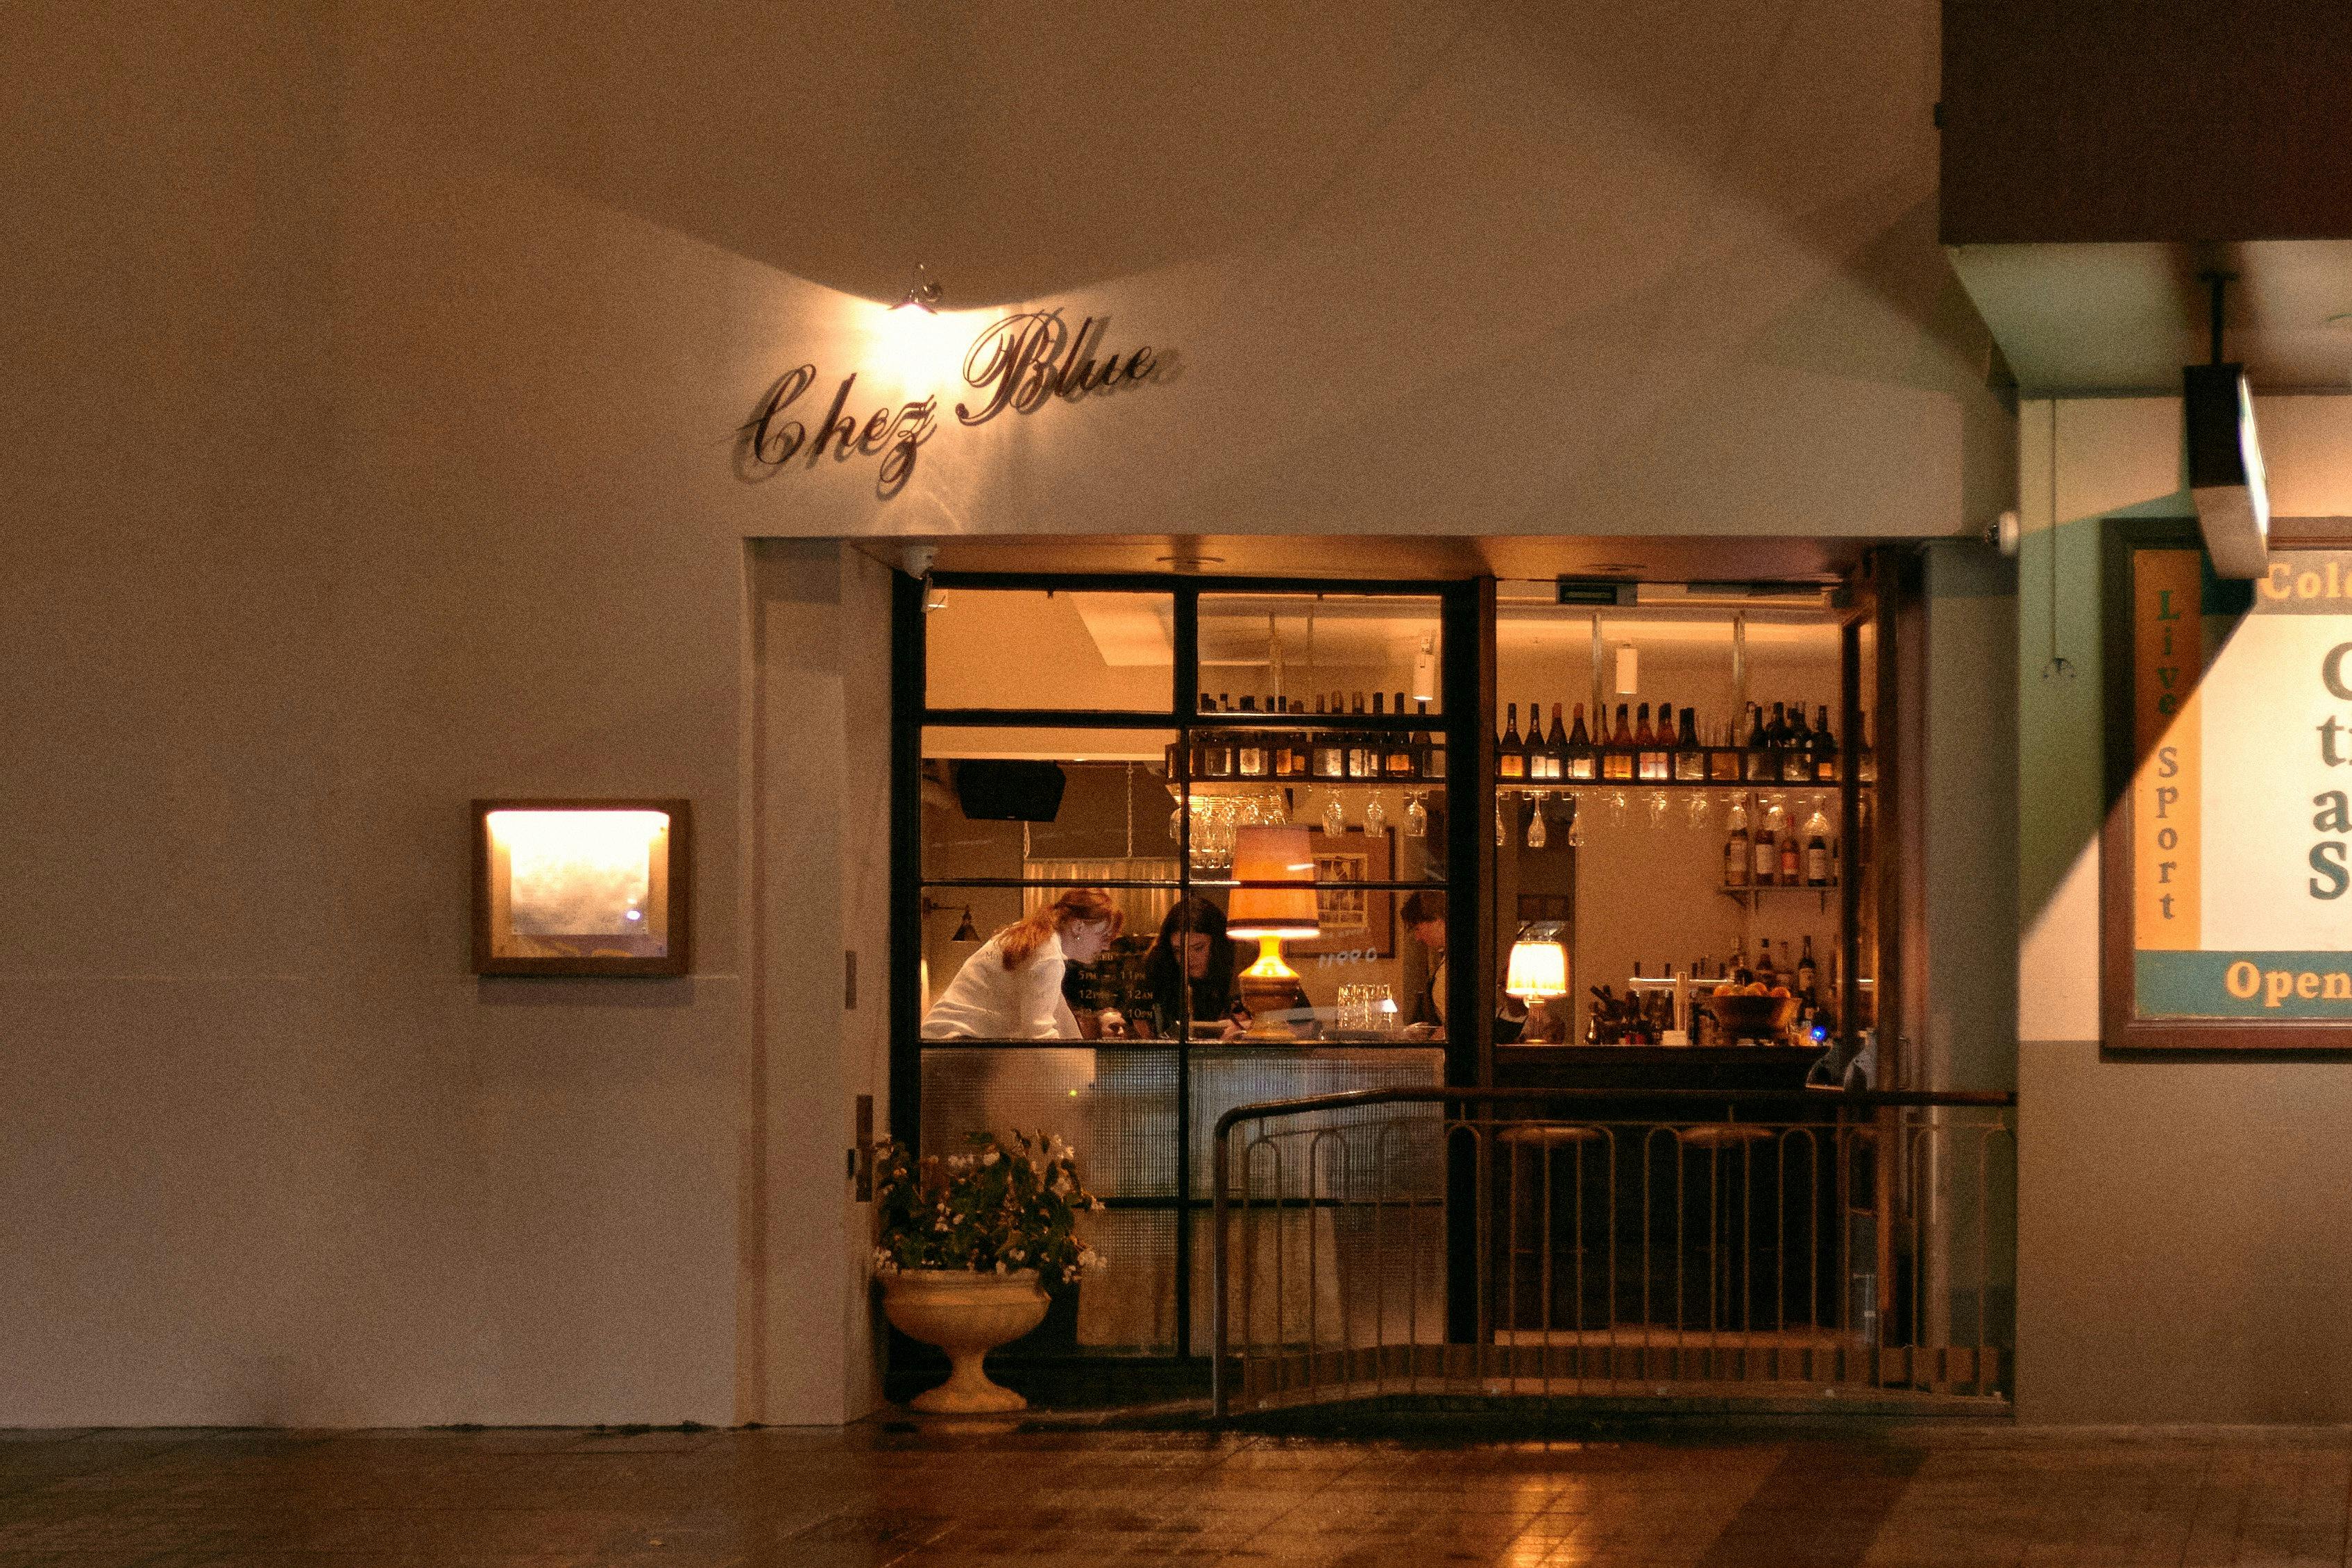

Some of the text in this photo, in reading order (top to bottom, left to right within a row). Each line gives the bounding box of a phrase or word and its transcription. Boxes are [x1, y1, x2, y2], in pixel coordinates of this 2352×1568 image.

[737, 307, 1158, 484] Chez Blue
[2257, 562, 2352, 599] Col
[2156, 588, 2179, 919] Live Sport
[2224, 960, 2352, 1008] Open
